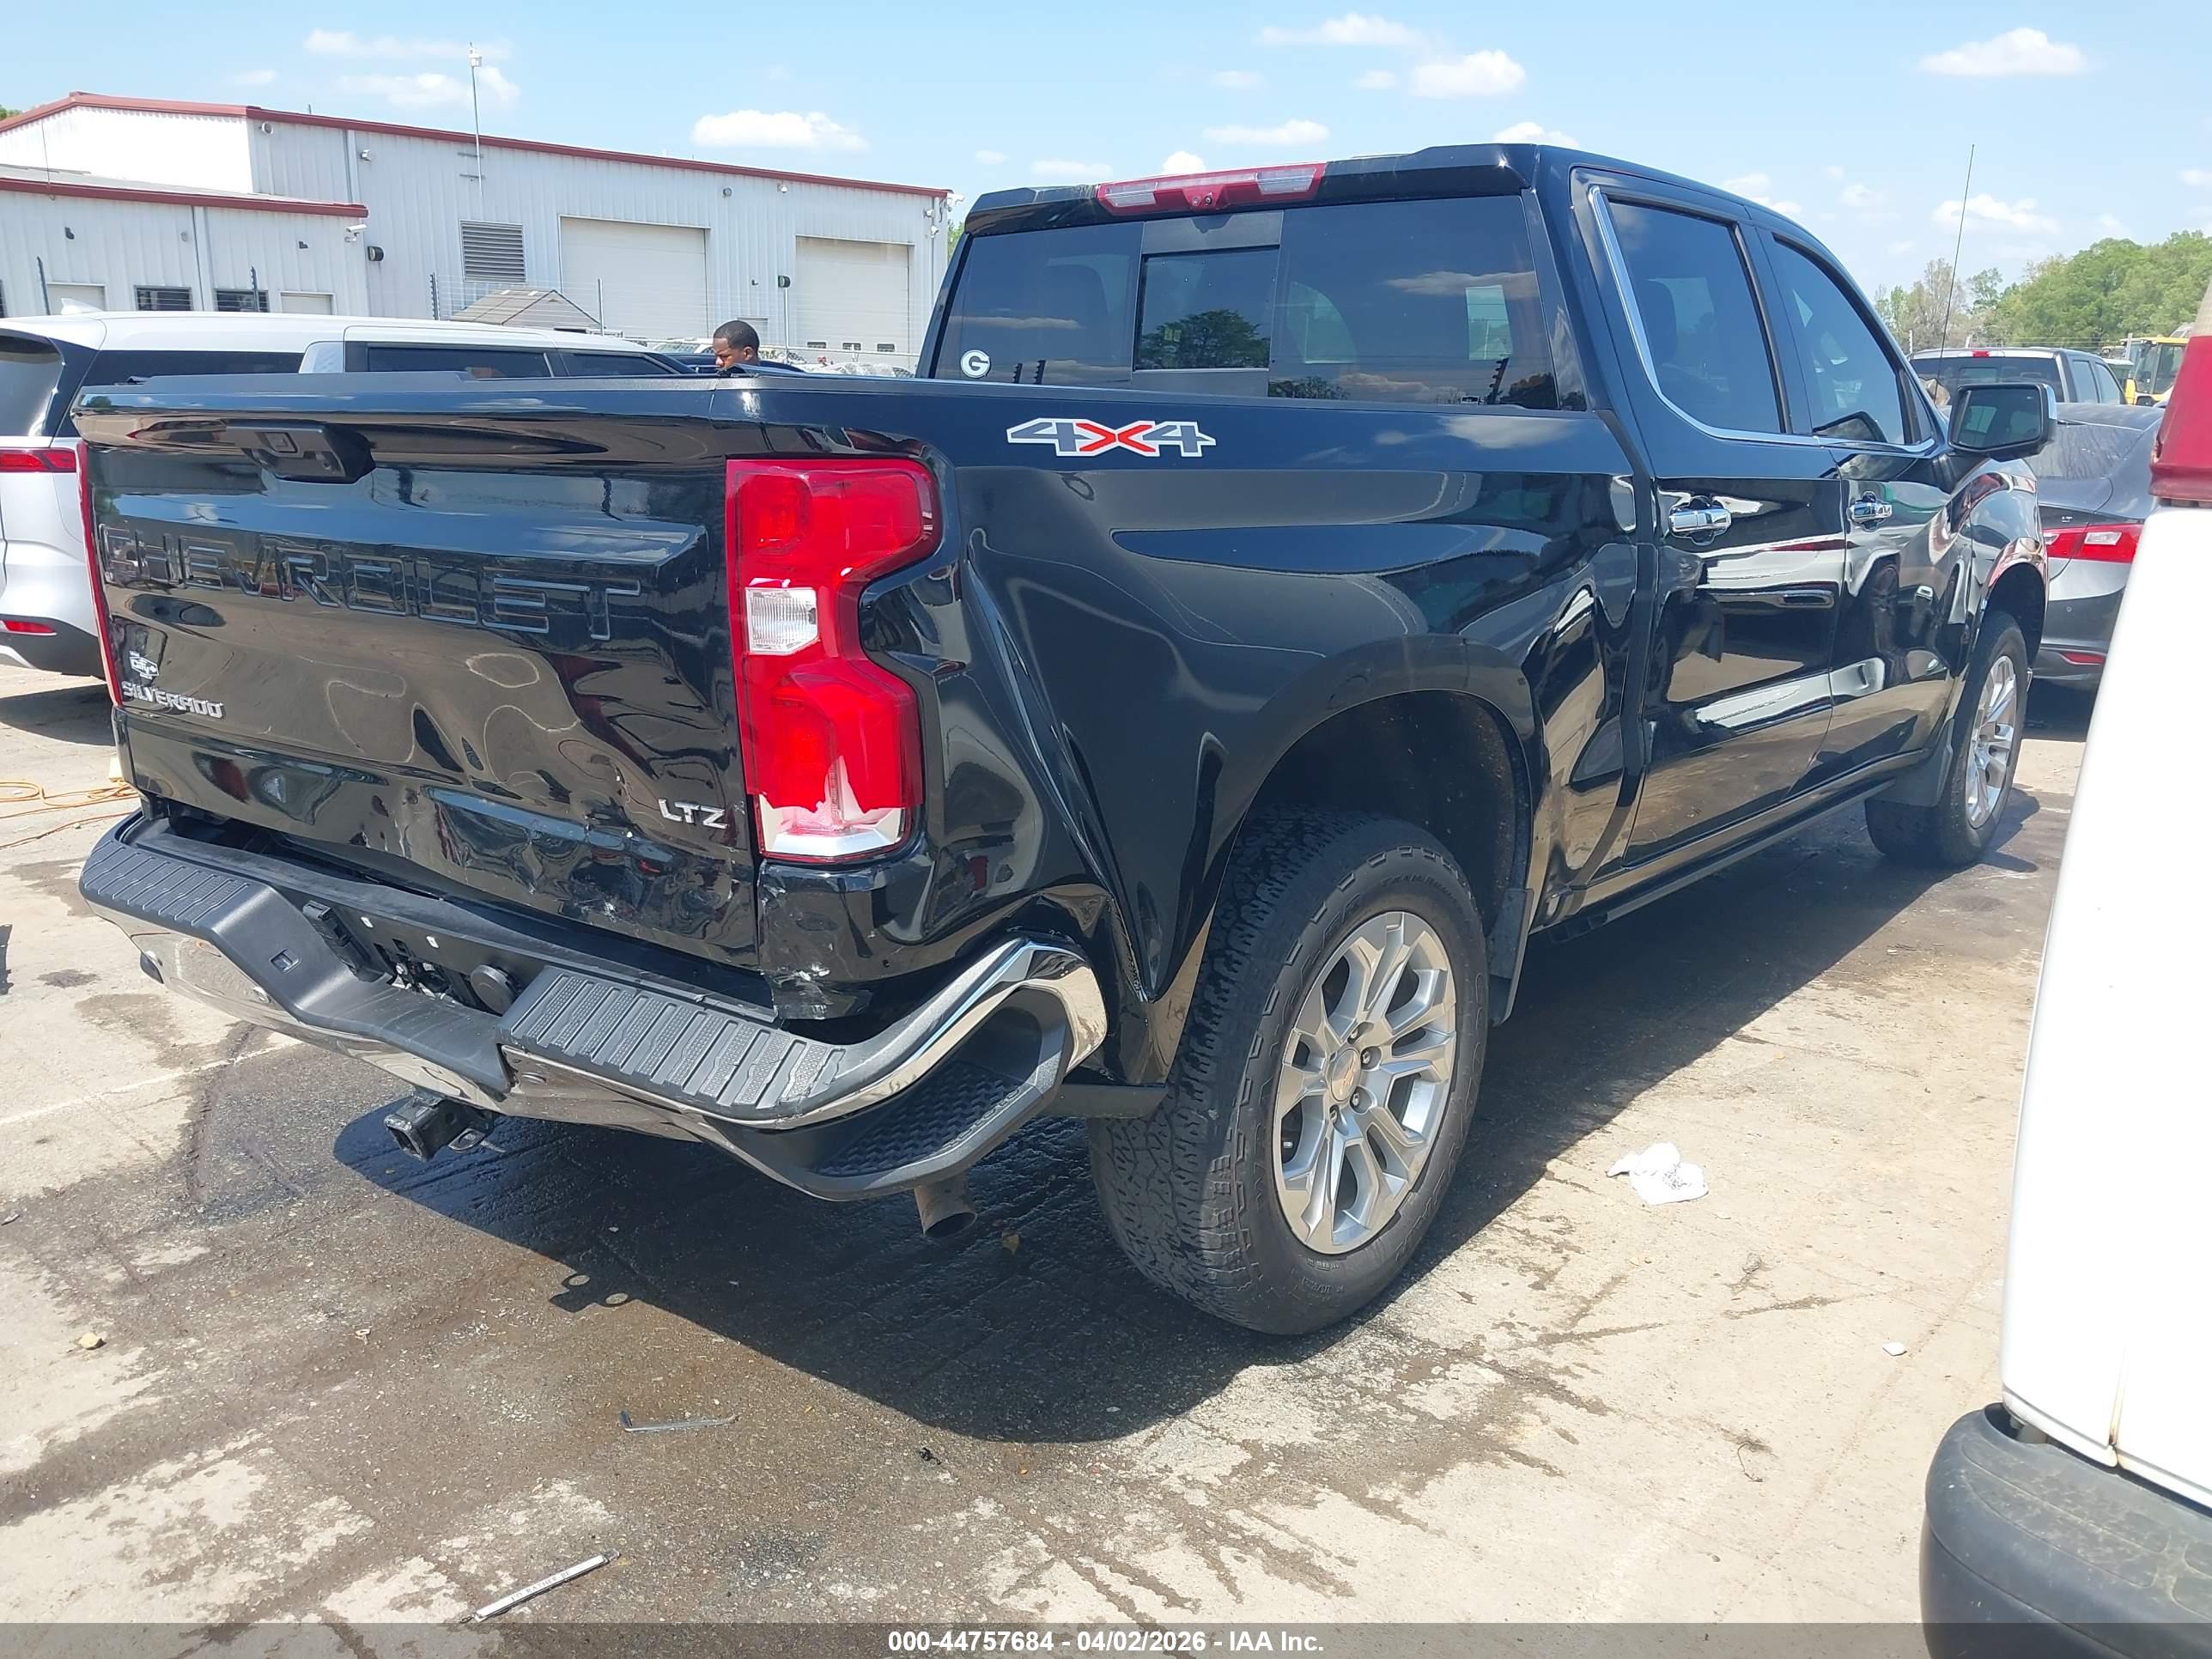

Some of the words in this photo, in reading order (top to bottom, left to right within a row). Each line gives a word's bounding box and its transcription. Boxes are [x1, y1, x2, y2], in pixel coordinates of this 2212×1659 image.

[960, 349, 991, 378] G
[99, 523, 641, 641] CHEVROLET
[121, 680, 224, 720] SILVERADO
[659, 799, 728, 830] LTZ
